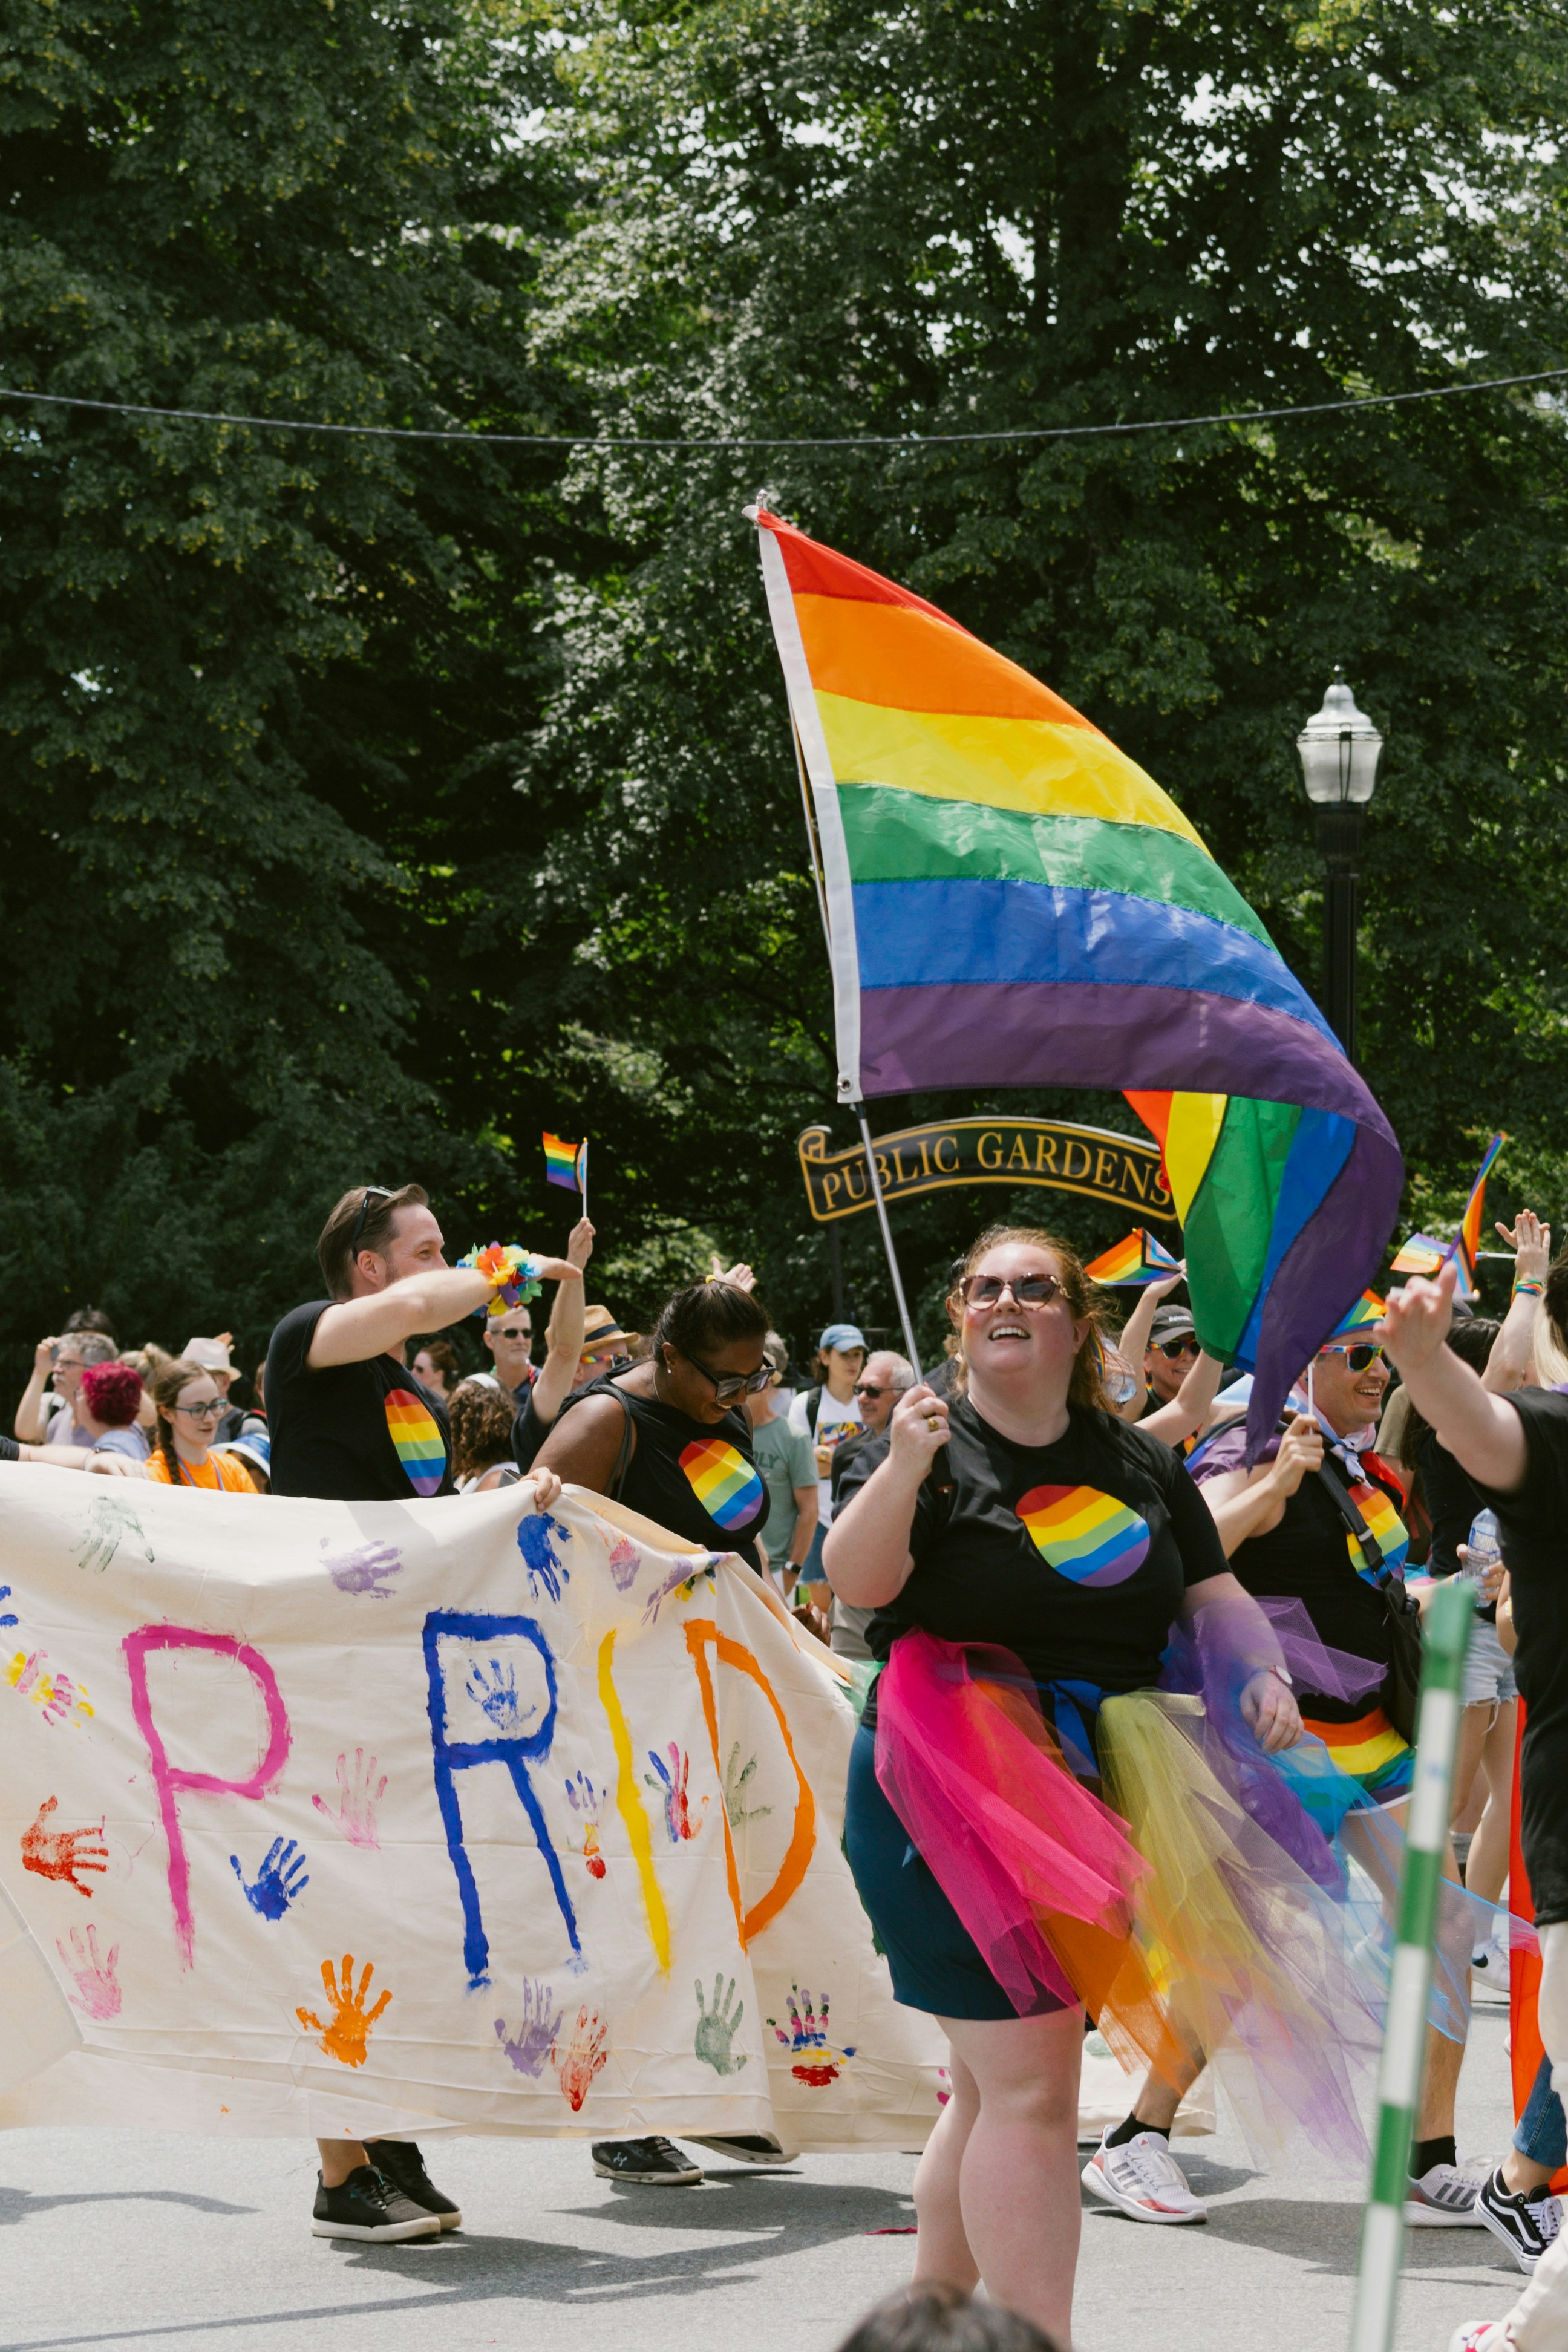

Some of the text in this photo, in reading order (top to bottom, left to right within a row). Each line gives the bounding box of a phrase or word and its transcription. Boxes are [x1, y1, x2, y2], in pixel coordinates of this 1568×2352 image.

[822, 1132, 1171, 1210] PUBLIC GARDENS
[118, 1607, 886, 1991] PRID
